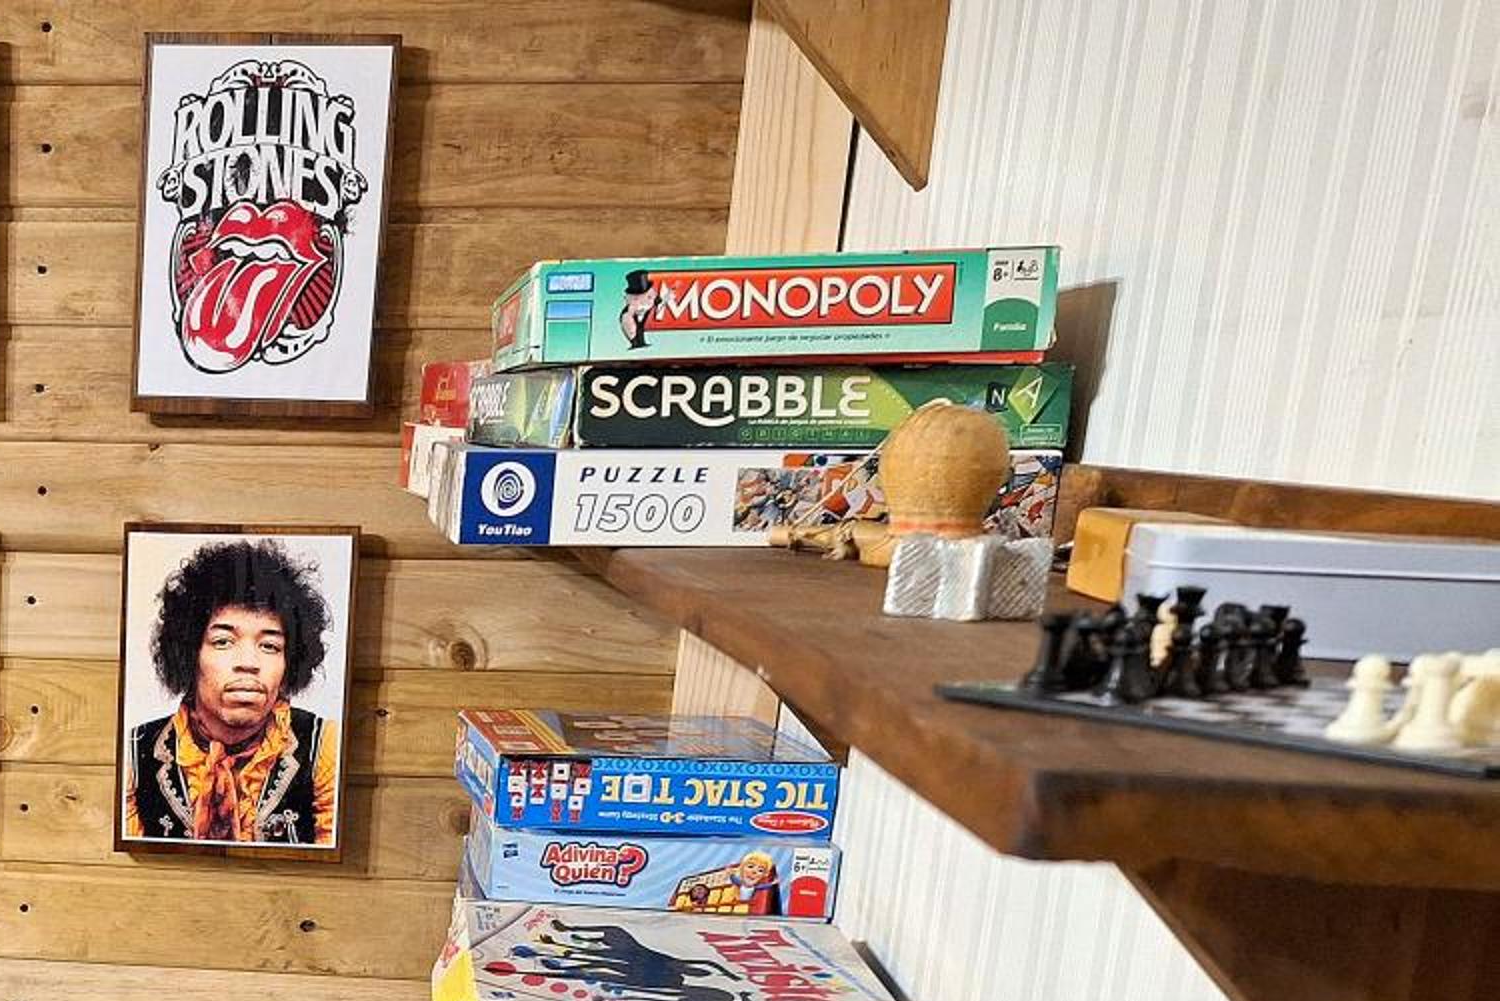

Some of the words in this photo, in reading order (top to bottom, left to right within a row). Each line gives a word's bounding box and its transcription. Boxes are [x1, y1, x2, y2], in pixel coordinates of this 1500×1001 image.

[174, 87, 354, 164] ROLLING
[180, 144, 340, 220] STONES
[654, 273, 945, 322] MONOPOLY
[590, 374, 872, 427] SCRABBLE
[579, 466, 709, 483] PUZZLE
[574, 493, 706, 533] 1500
[683, 778, 768, 808] STAC
[775, 780, 828, 810] TIC
[545, 845, 618, 865] Adivina
